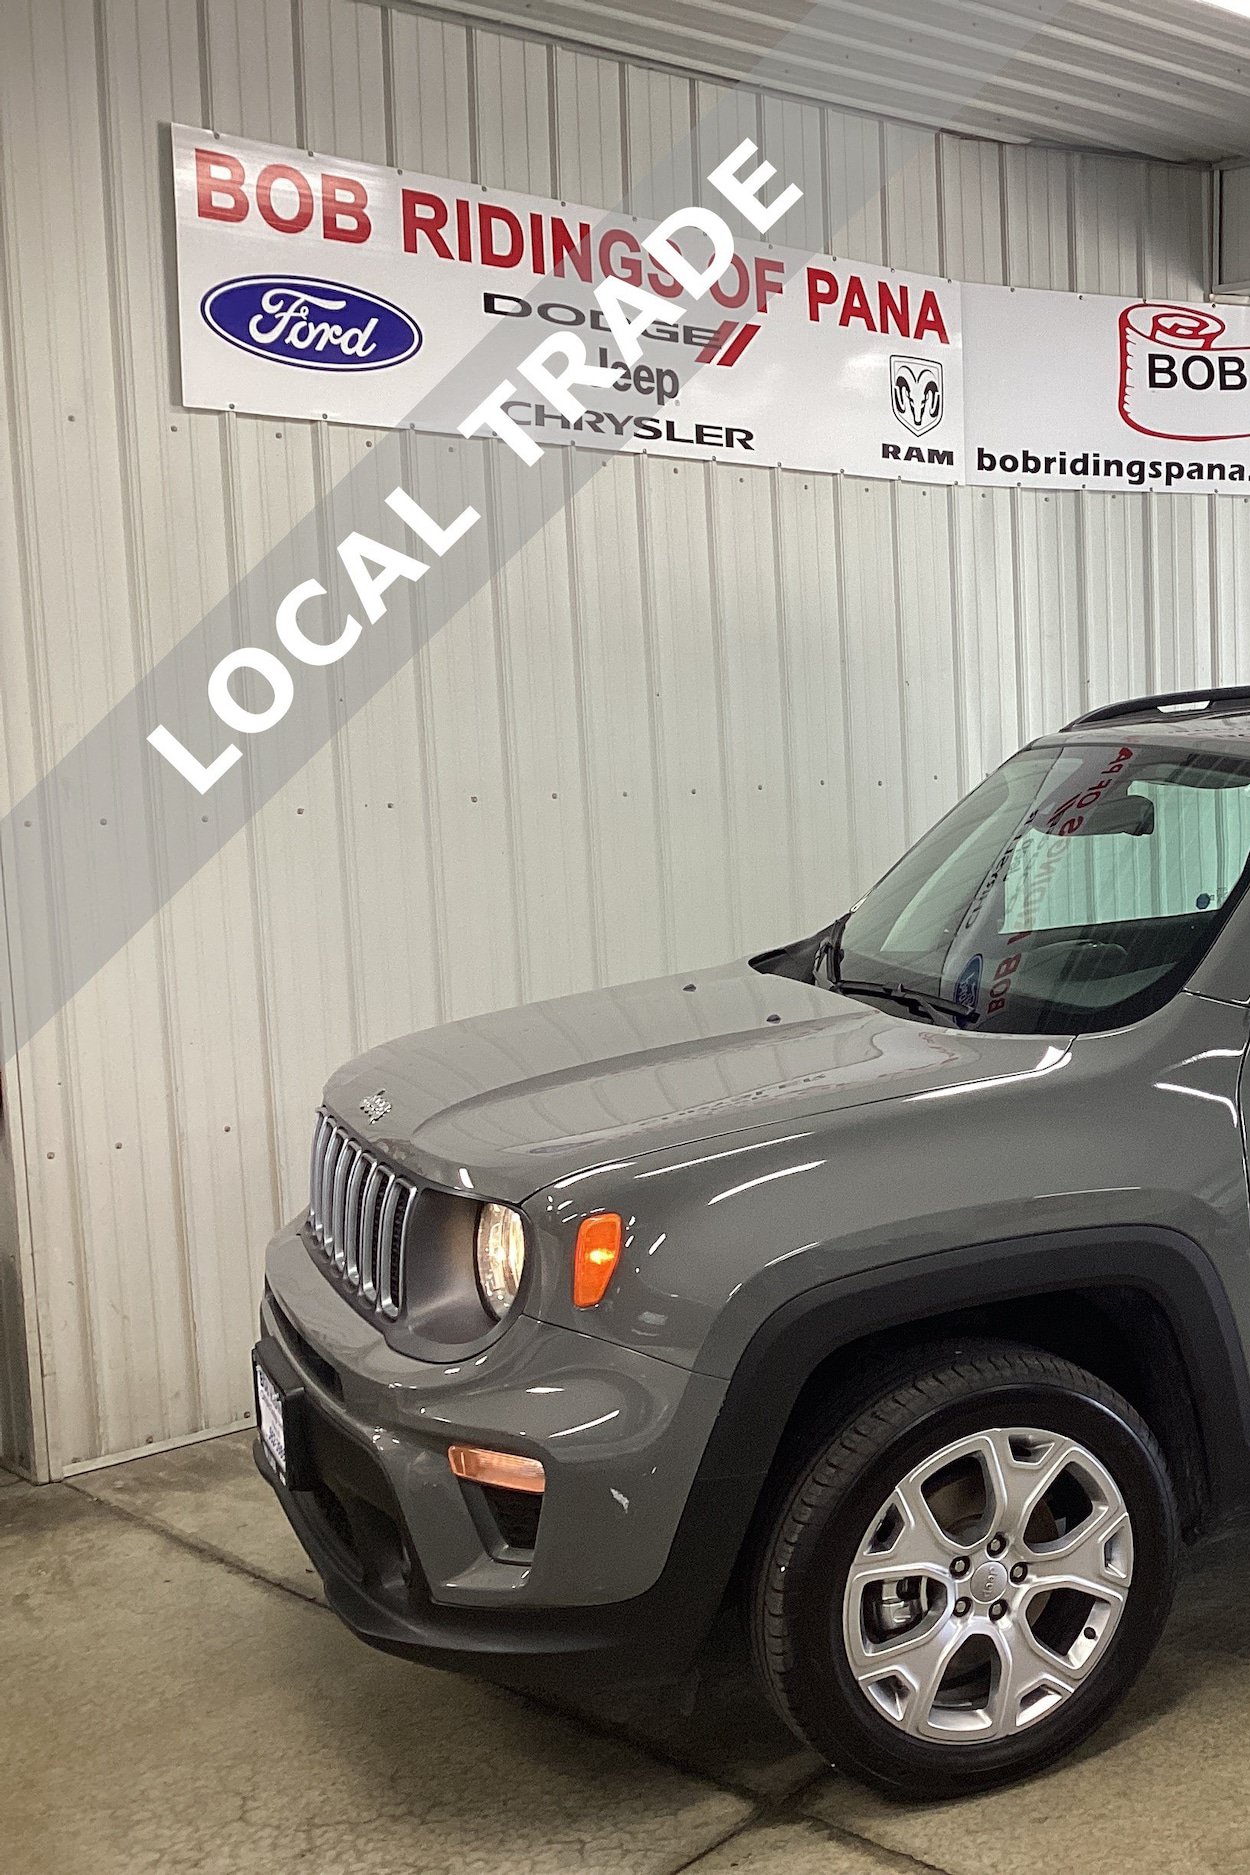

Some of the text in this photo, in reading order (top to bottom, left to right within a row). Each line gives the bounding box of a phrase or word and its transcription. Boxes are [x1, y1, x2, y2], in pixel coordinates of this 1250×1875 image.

[193, 148, 950, 344] BOB RIDINGS OF PANA
[247, 288, 377, 359] Ford
[483, 292, 721, 349] DODGE
[1147, 353, 1248, 391] BOB
[499, 400, 755, 450] CHRYSLER
[882, 442, 955, 467] RAM
